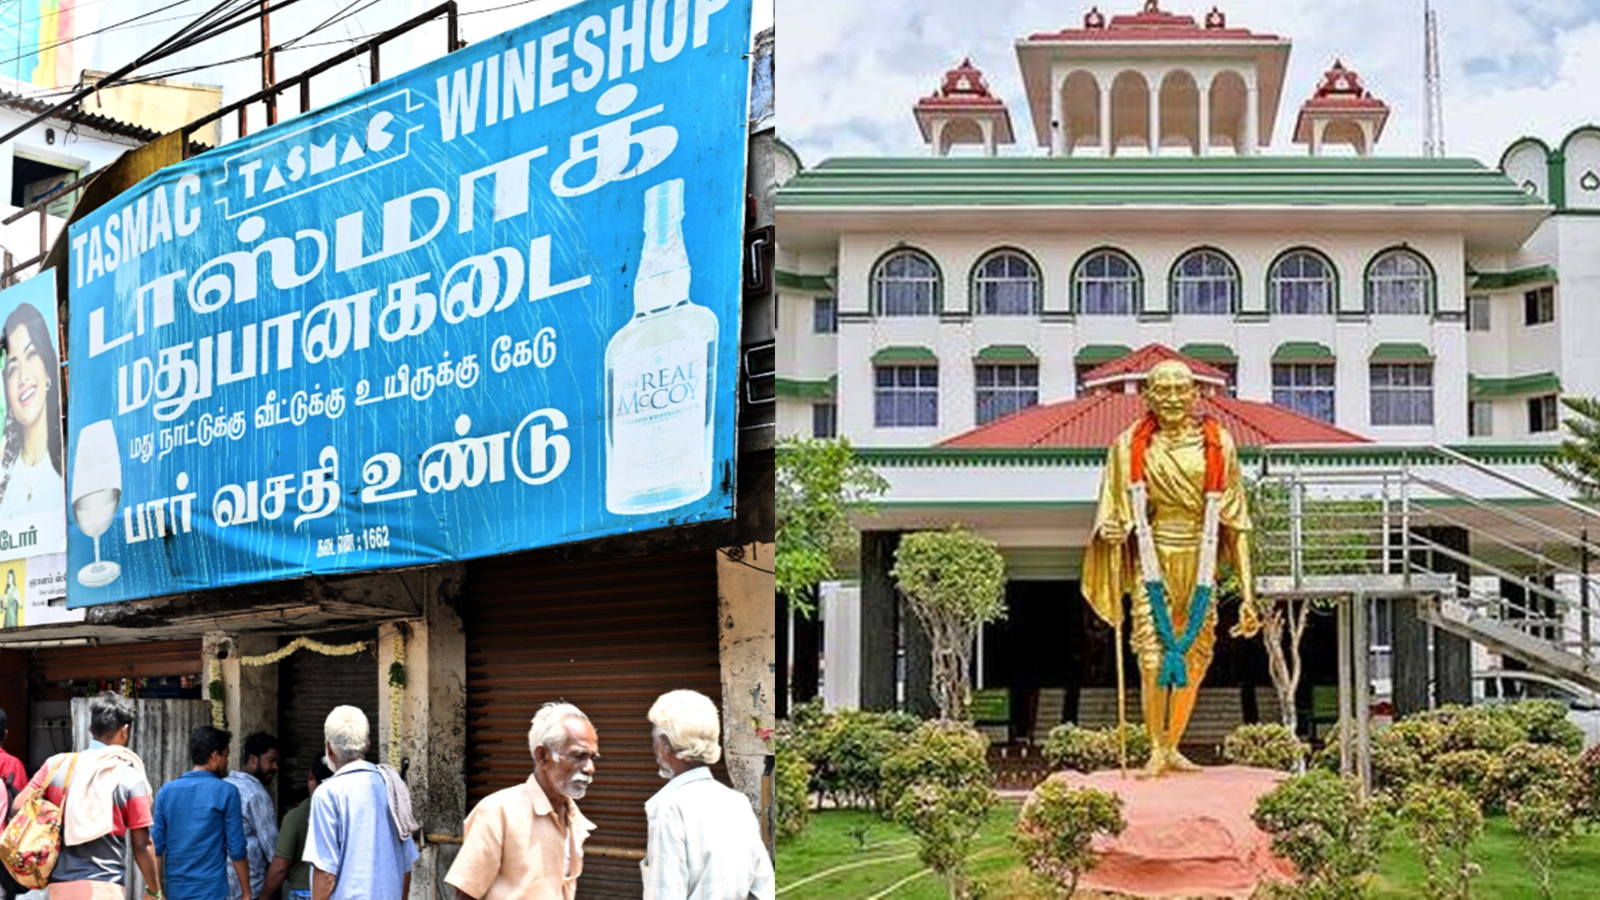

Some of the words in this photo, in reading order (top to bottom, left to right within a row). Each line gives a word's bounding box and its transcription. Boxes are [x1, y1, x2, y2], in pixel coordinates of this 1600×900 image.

[436, 0, 729, 142] WINESHOP
[89, 83, 679, 358] டாஸ்மாக்
[239, 110, 395, 199] TASMAC
[72, 174, 201, 289] TASMAC
[118, 234, 591, 421] மதுபானகடை
[130, 432, 153, 463] மது
[158, 406, 246, 461] நாட்டுக்கு
[254, 383, 346, 430] வீட்டுக்கு
[355, 351, 479, 406] உயிருக்கு
[491, 327, 557, 372] கேடு
[642, 361, 698, 391] REAL
[124, 472, 197, 544] பார்
[212, 446, 341, 532] வசதி
[361, 408, 571, 503] உண்டு
